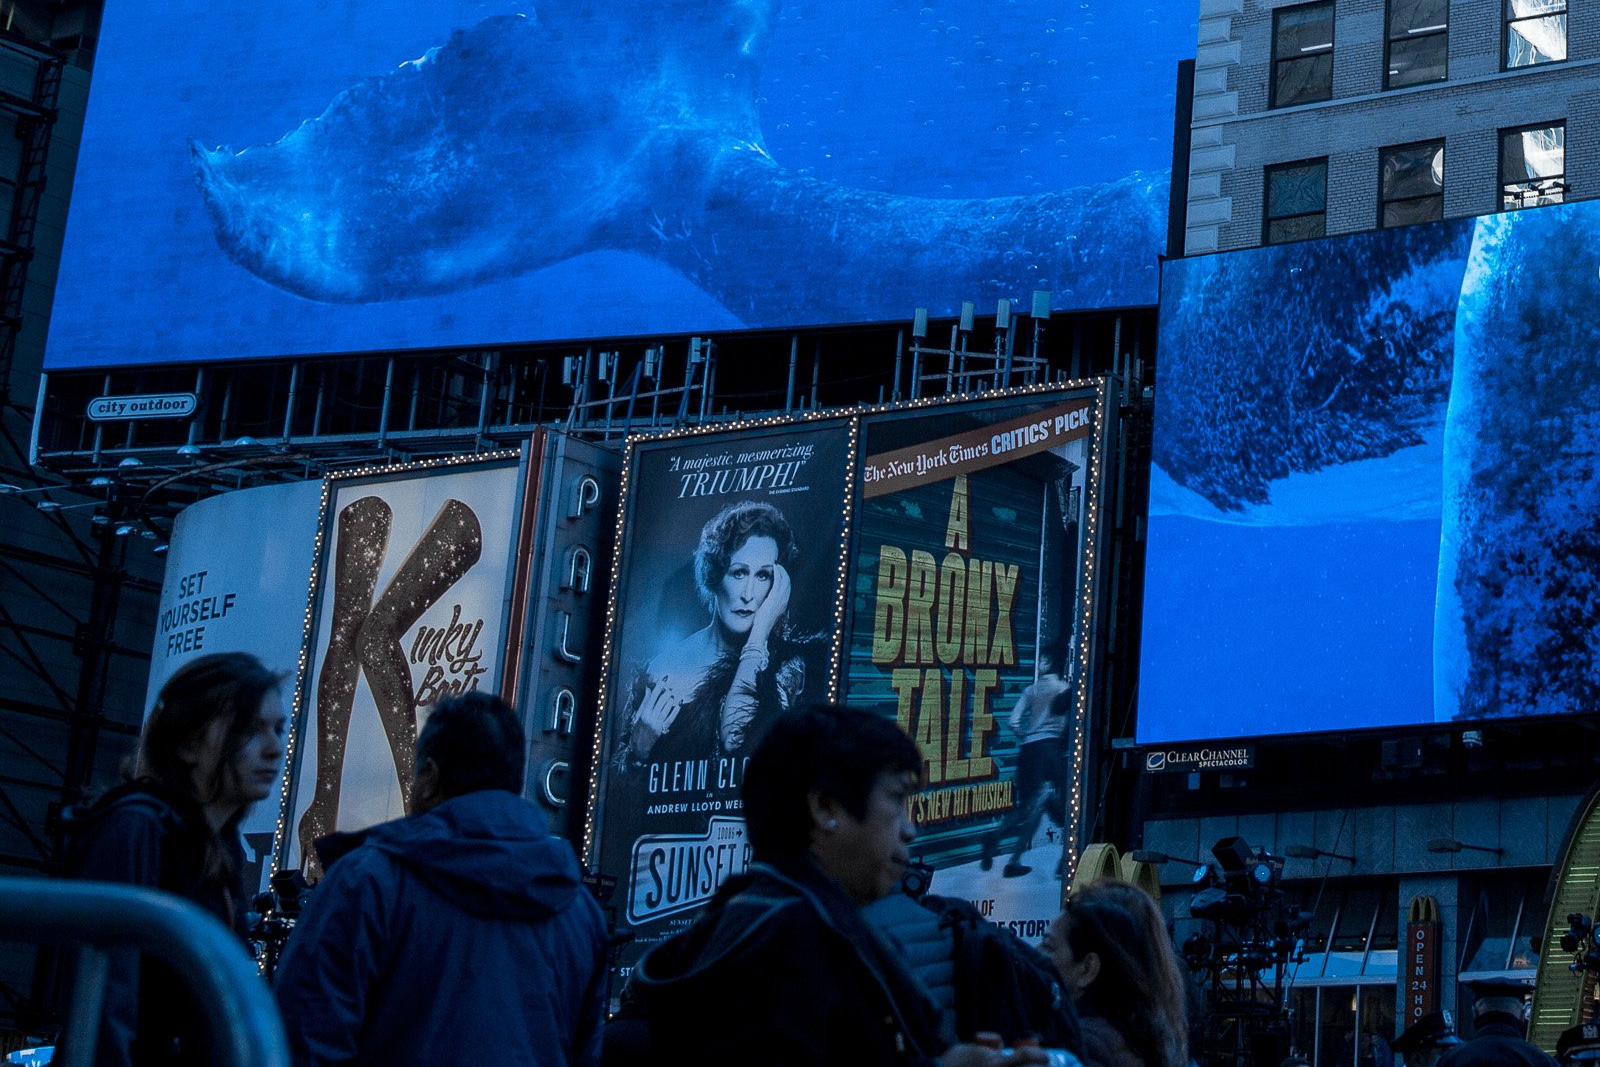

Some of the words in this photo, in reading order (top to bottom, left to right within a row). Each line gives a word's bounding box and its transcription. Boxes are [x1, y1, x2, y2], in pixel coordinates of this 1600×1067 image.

[98, 401, 127, 415] city
[130, 399, 188, 412] outdoor
[863, 463, 887, 483] The
[887, 459, 915, 479] New
[916, 449, 948, 476] York
[949, 441, 989, 465] Times
[1054, 406, 1090, 436] PICK
[945, 473, 969, 551] A
[178, 570, 208, 600] SET
[160, 593, 237, 635] YOURSELF
[871, 544, 1020, 666] BRONX
[166, 627, 206, 658] FREE
[540, 473, 601, 840] PALAC
[891, 668, 999, 784] TALE
[649, 759, 708, 793] GLENN
[1198, 759, 1248, 768] SPECTACOLOR
[647, 803, 689, 815] ANDREW
[691, 801, 722, 812] LLOYD
[926, 790, 951, 819] NEW
[952, 786, 971, 817] HIT
[971, 780, 1014, 814] MUSICAL
[645, 843, 737, 909] SUNSET
[981, 899, 995, 917] OF
[1415, 929, 1425, 976] OPEN
[1412, 980, 1428, 992] 24
